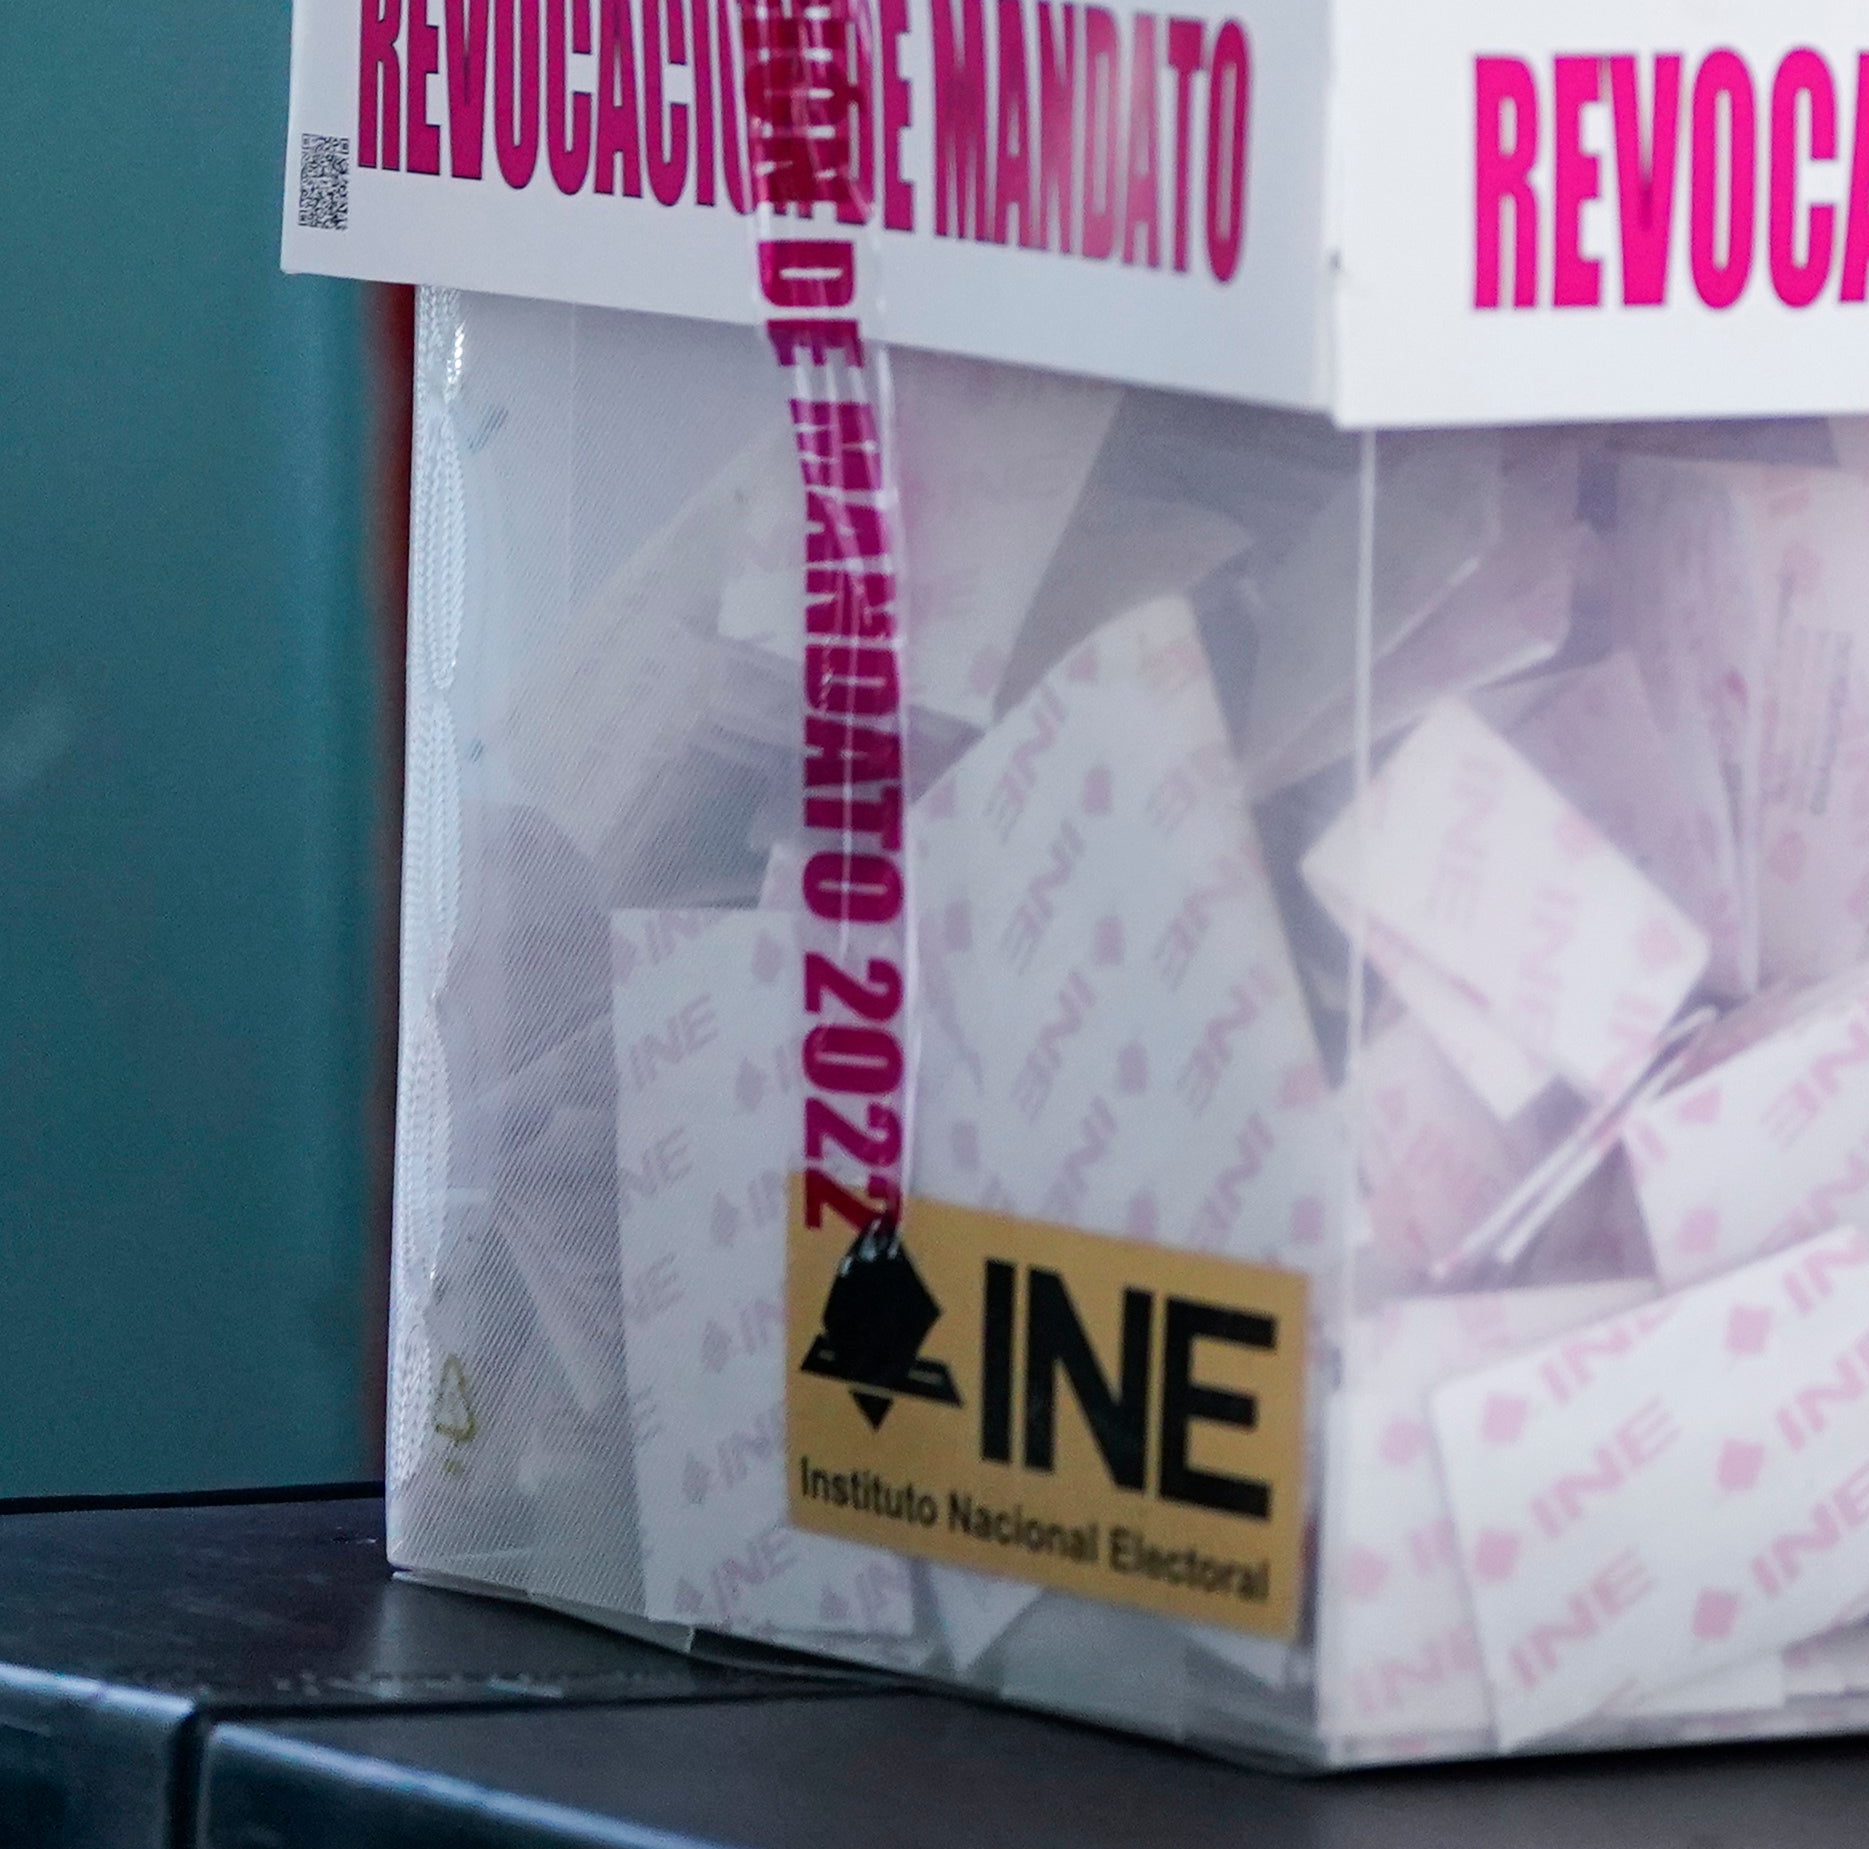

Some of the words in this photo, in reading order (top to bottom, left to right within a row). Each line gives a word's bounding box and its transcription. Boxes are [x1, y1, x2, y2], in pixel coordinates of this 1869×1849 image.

[758, 239, 865, 368] DE
[790, 397, 905, 925] MANDATO
[802, 951, 906, 1233] 2022
[980, 1256, 1278, 1523] INE
[800, 1457, 938, 1528] Instituto
[948, 1489, 1099, 1564] Nacional
[1108, 1526, 1270, 1604] Electoral
[1530, 1395, 1681, 1539] INE
[1508, 1548, 1658, 1691] INE
